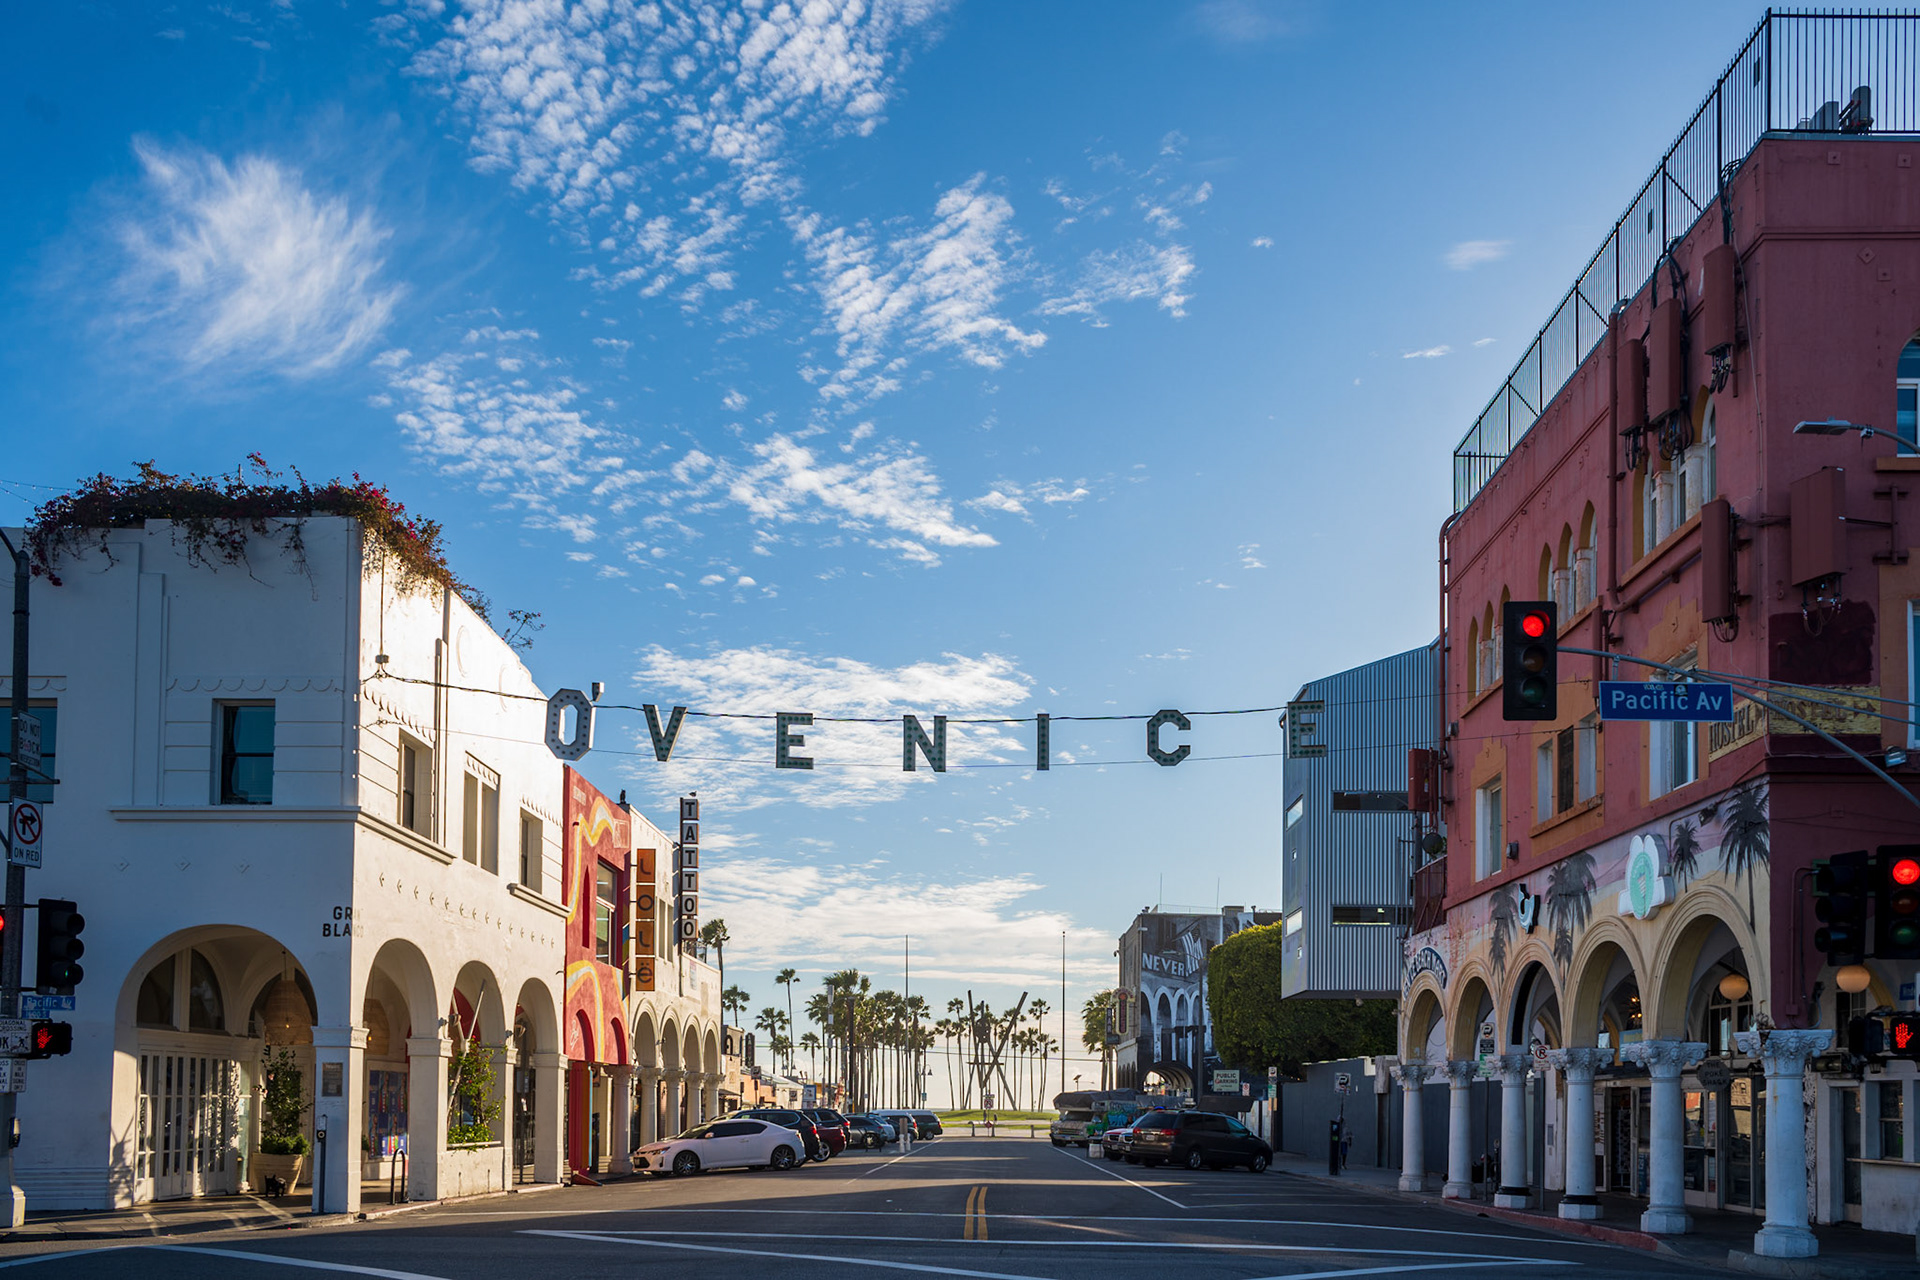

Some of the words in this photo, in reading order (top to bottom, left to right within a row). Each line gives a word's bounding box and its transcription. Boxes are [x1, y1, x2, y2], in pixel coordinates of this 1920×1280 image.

[1612, 690, 1688, 710] Pacific
[1696, 691, 1723, 710] Av
[1709, 704, 1754, 754] HOSTEL
[15, 847, 24, 859] ON
[26, 849, 40, 862] RED
[684, 802, 695, 936] TATTOO
[1142, 952, 1185, 977] NEVER
[27, 996, 57, 1008] Pacific
